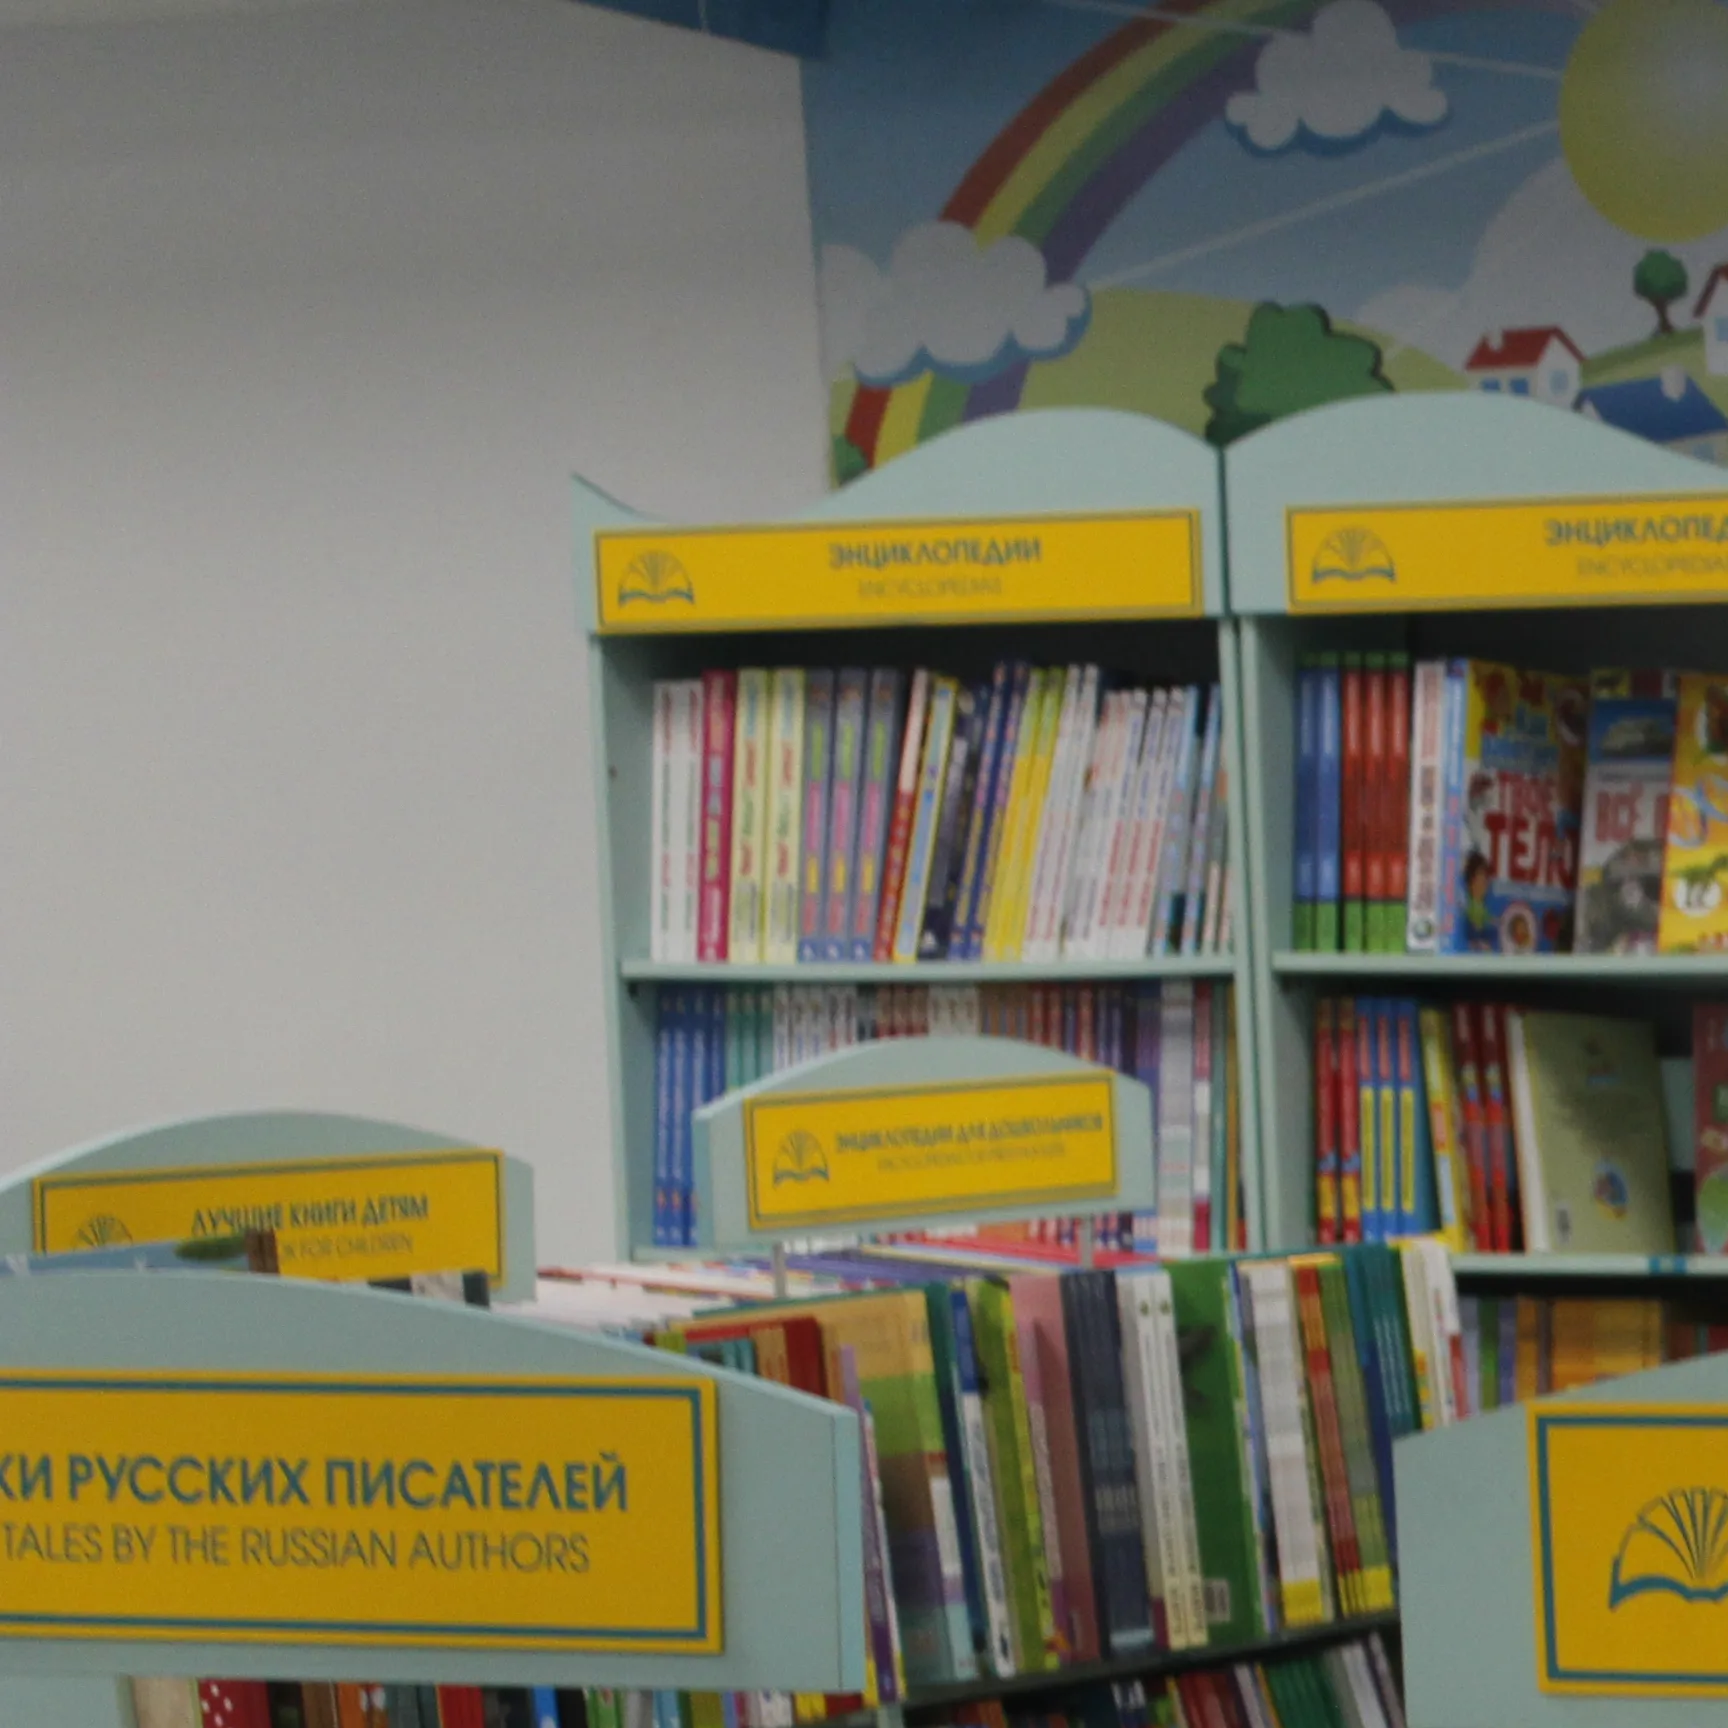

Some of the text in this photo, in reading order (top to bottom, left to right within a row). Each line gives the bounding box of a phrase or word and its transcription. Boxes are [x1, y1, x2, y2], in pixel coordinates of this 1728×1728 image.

[827, 537, 1042, 570] ЭНЦИКЛОПЕДИИ
[290, 1199, 356, 1230] КНИГИ
[361, 1193, 429, 1228] ДЕТЯМ
[70, 1454, 308, 1507] РУССКИХ
[326, 1450, 628, 1514] ПИСАТЕЛЕЙ
[3, 1520, 591, 1574] TALES BY THE RUSSIAN AUTHORS
